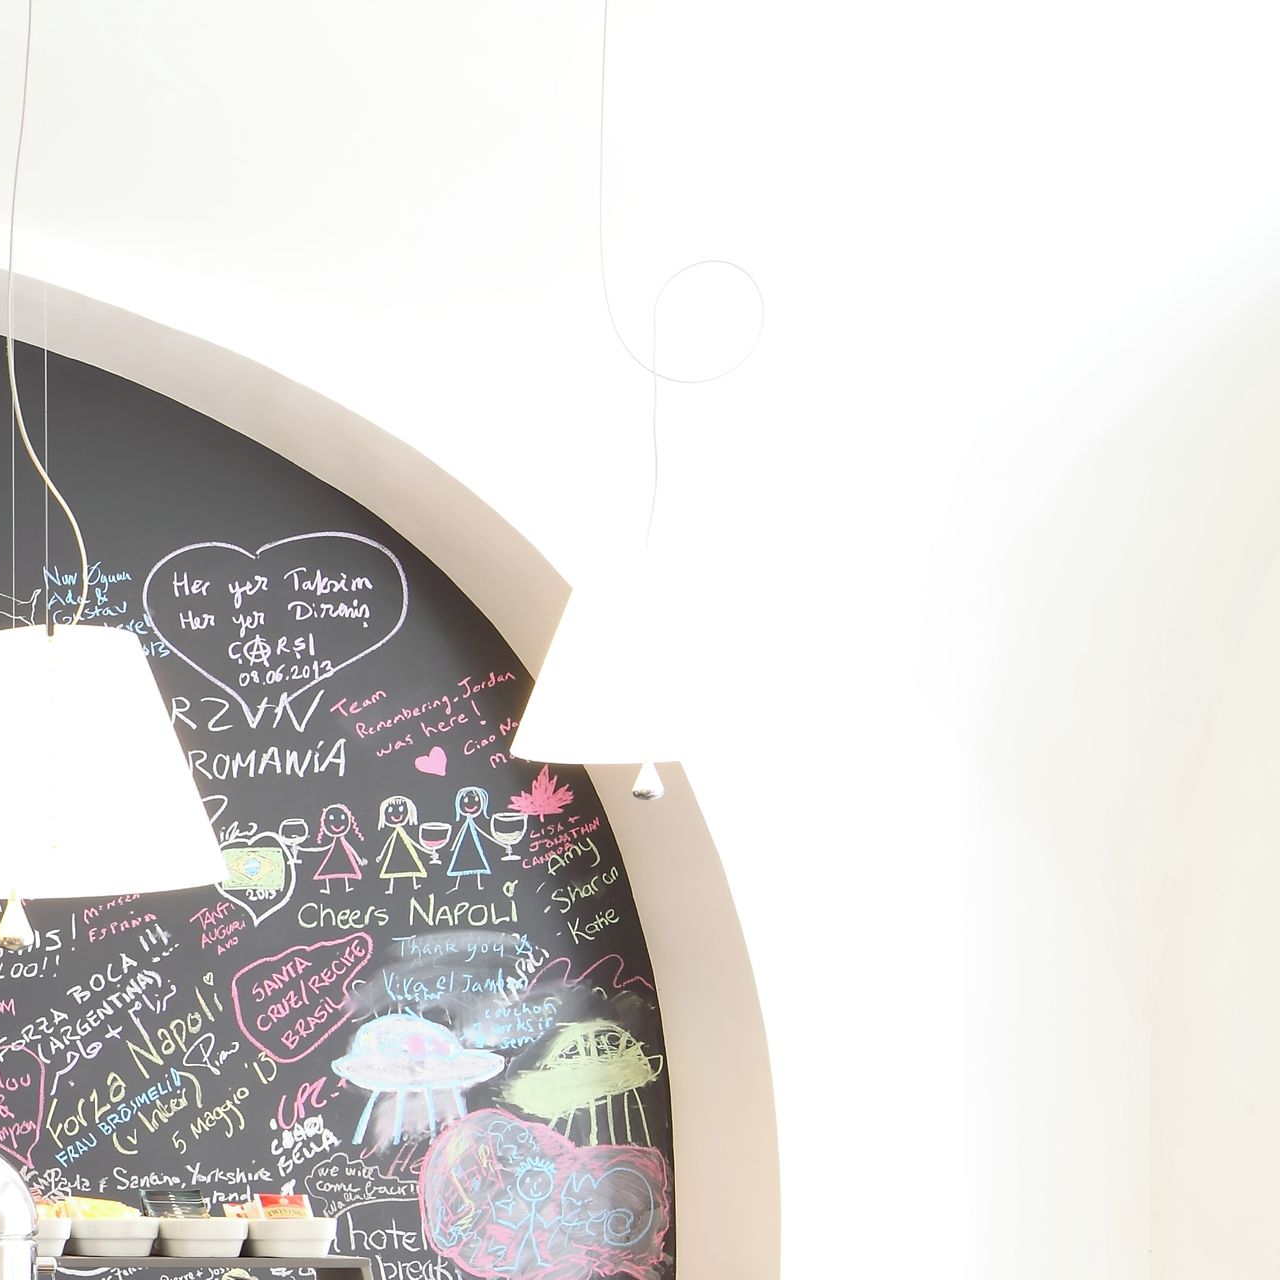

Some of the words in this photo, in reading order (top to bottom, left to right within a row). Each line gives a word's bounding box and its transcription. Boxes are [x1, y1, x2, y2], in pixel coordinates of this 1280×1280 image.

[173, 571, 210, 597] Her
[229, 574, 269, 609] yer
[284, 568, 372, 595] Taksim
[180, 610, 216, 630] Her
[232, 610, 265, 637] yer
[330, 690, 387, 717] Team
[377, 736, 413, 758] was
[463, 734, 496, 756] Ciao
[246, 889, 276, 899] 2013
[298, 902, 389, 929] Cheers
[409, 893, 518, 926] NAPOLI
[567, 908, 620, 944] Katie
[200, 921, 245, 949] AUGURI
[251, 957, 312, 1001] SANTA
[280, 996, 346, 1050] BRASIL
[348, 1211, 430, 1251] hotel
